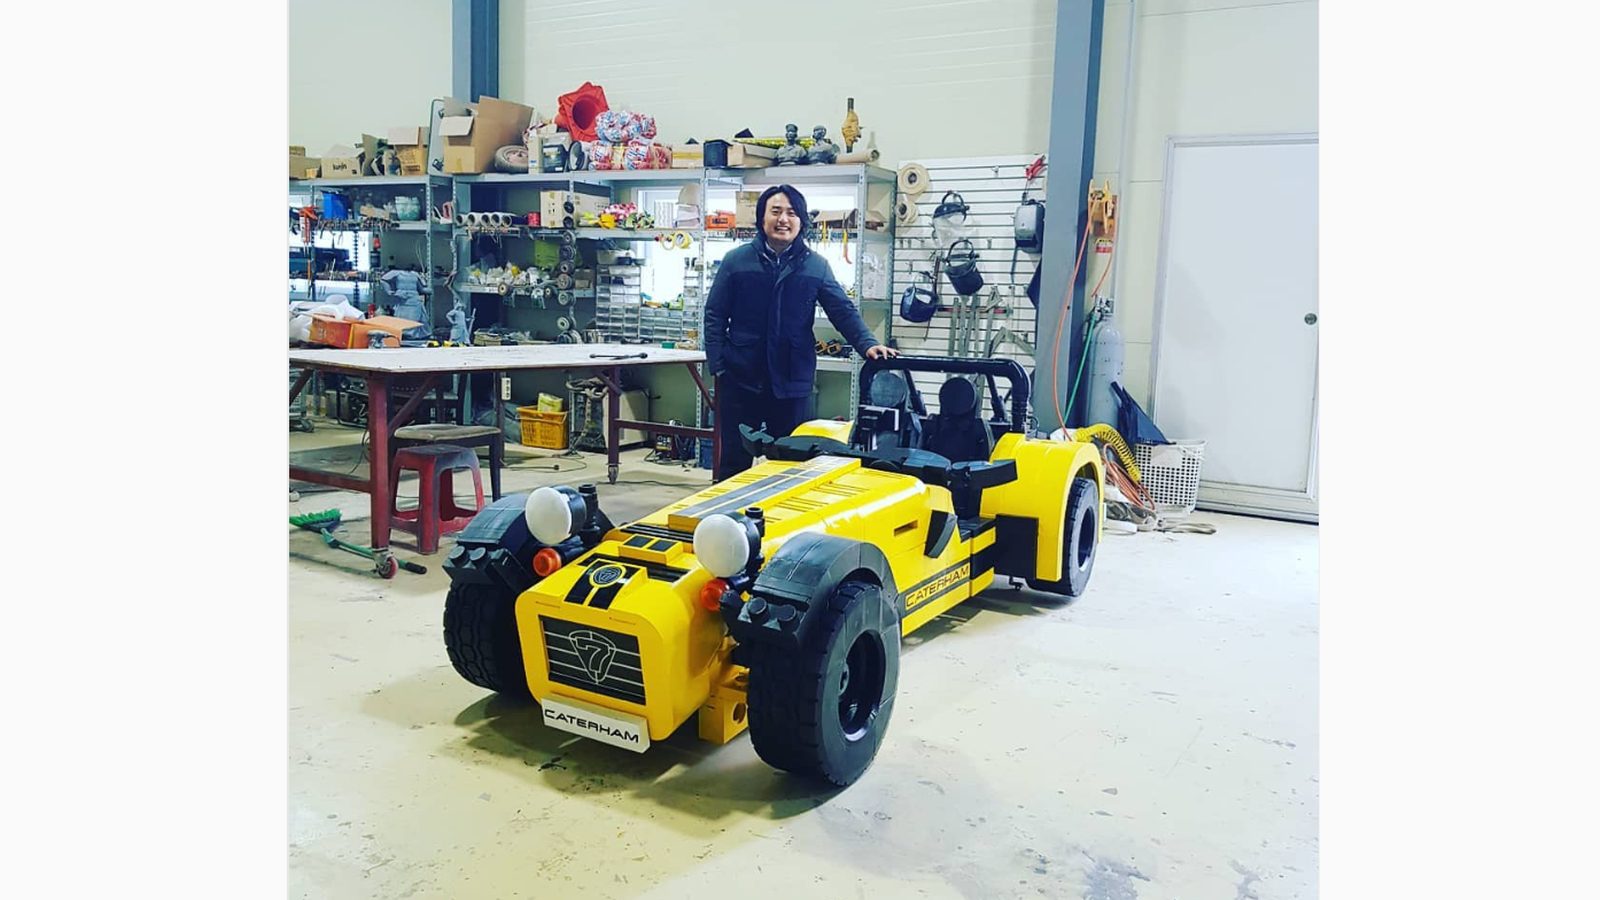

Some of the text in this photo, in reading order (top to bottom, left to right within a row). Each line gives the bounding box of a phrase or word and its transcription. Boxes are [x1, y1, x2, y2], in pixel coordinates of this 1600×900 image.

[906, 566, 969, 607] CATERHAM
[576, 637, 611, 674] 7
[544, 709, 639, 744] CATERHAM
